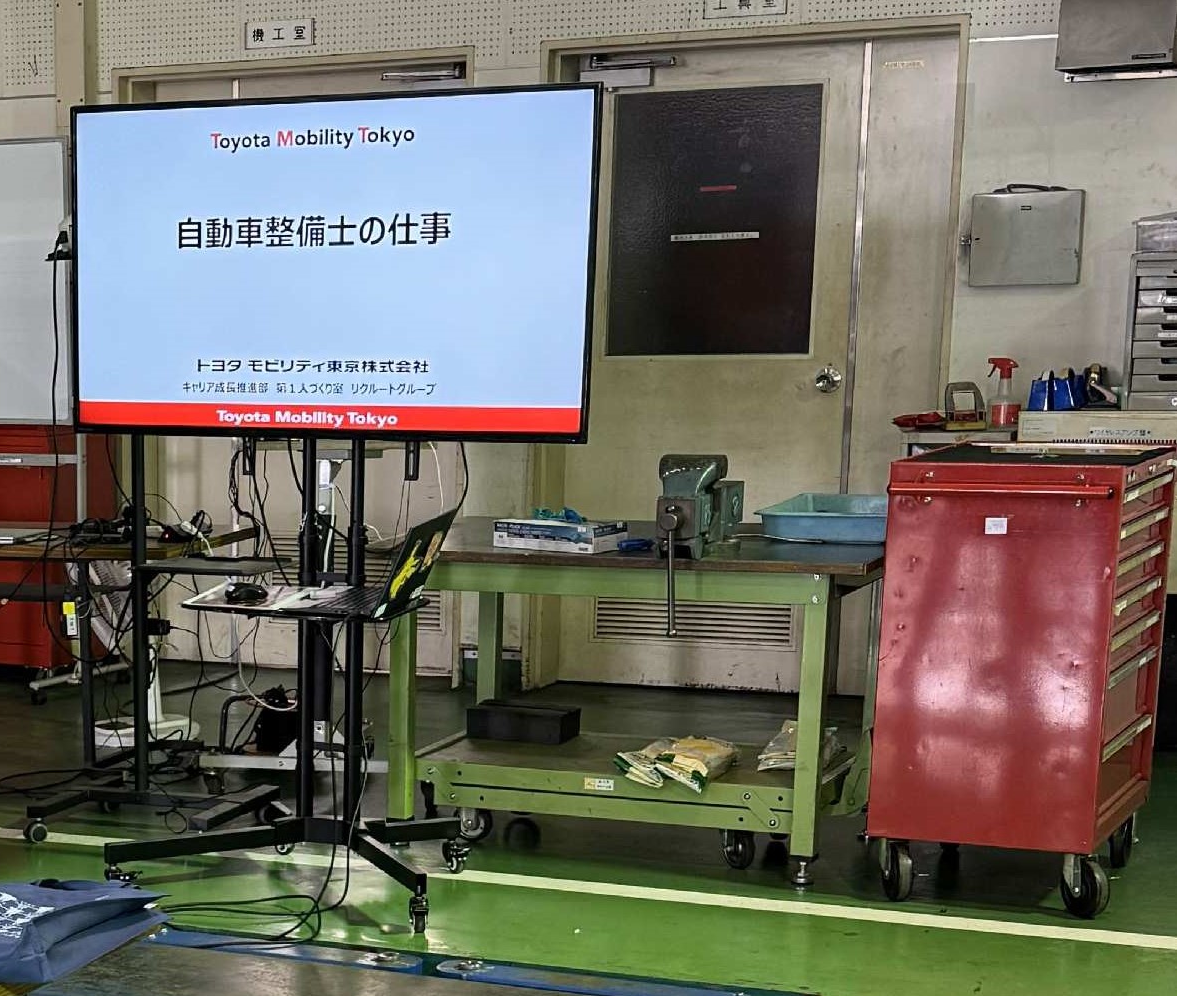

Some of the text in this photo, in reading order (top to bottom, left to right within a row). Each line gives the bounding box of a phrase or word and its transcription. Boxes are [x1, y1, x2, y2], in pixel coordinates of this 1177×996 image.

[210, 126, 415, 154] Toyota Mobility Tokyo
[178, 211, 452, 249] 自動車整備士の仕事
[197, 358, 242, 372] トヨタ
[351, 383, 438, 396] リクルートグループ
[215, 408, 399, 428] Toyota Mobility Tokyo
